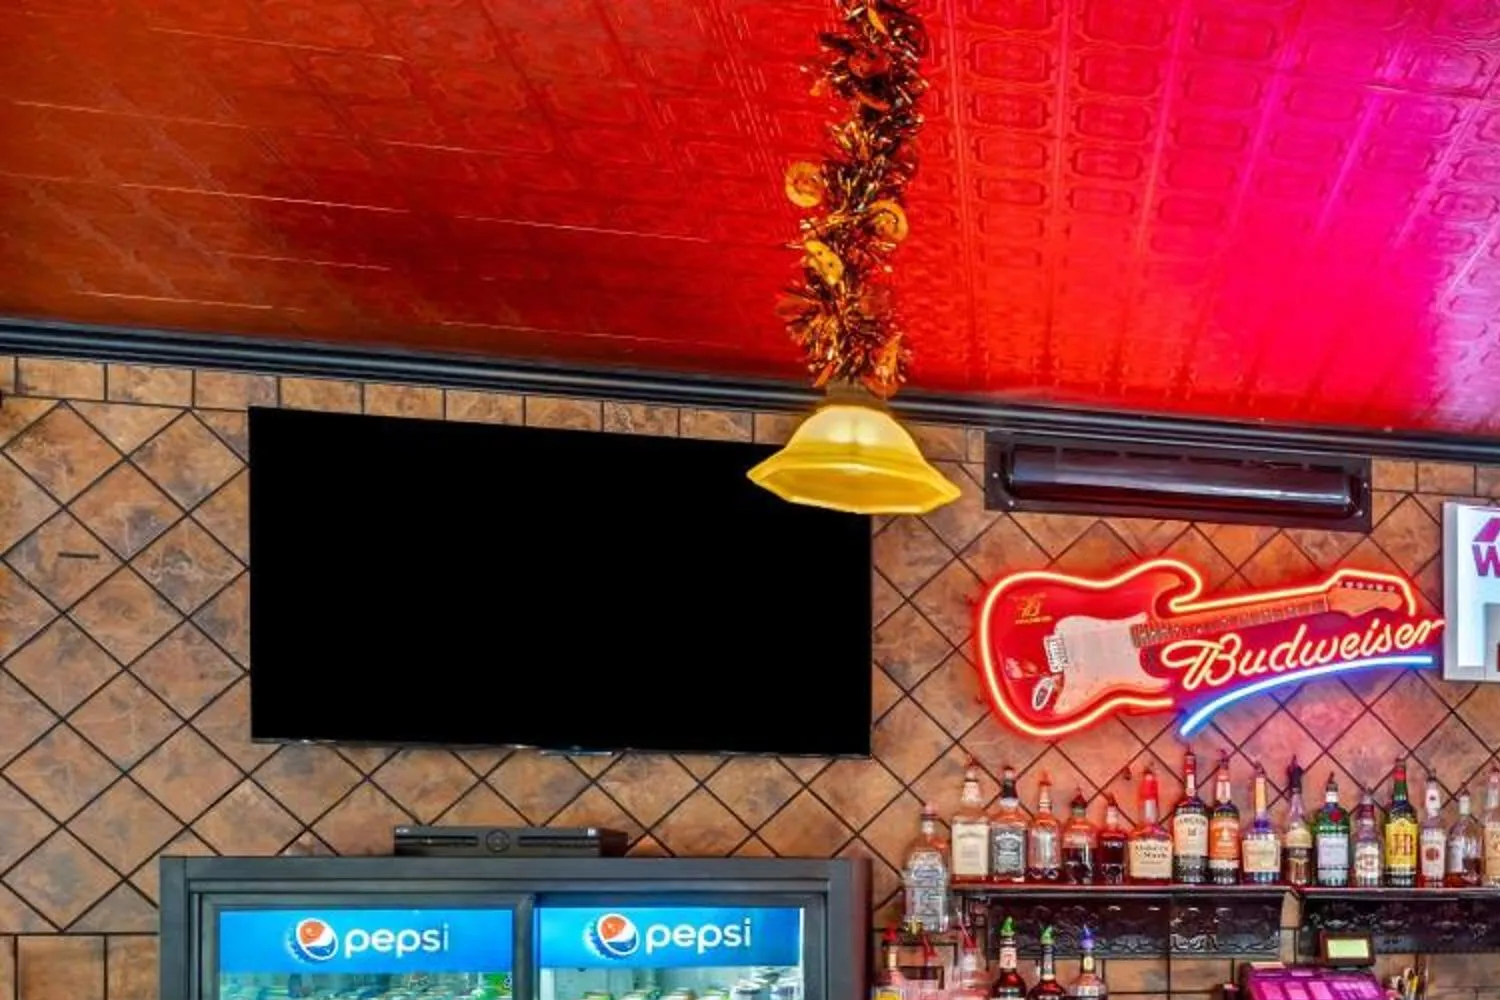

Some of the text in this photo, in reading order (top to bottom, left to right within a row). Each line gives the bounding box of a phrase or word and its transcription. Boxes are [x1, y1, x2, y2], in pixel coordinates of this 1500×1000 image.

[1160, 617, 1445, 691] Budweiser
[344, 922, 450, 959] pepsi
[645, 917, 751, 955] pepsi
